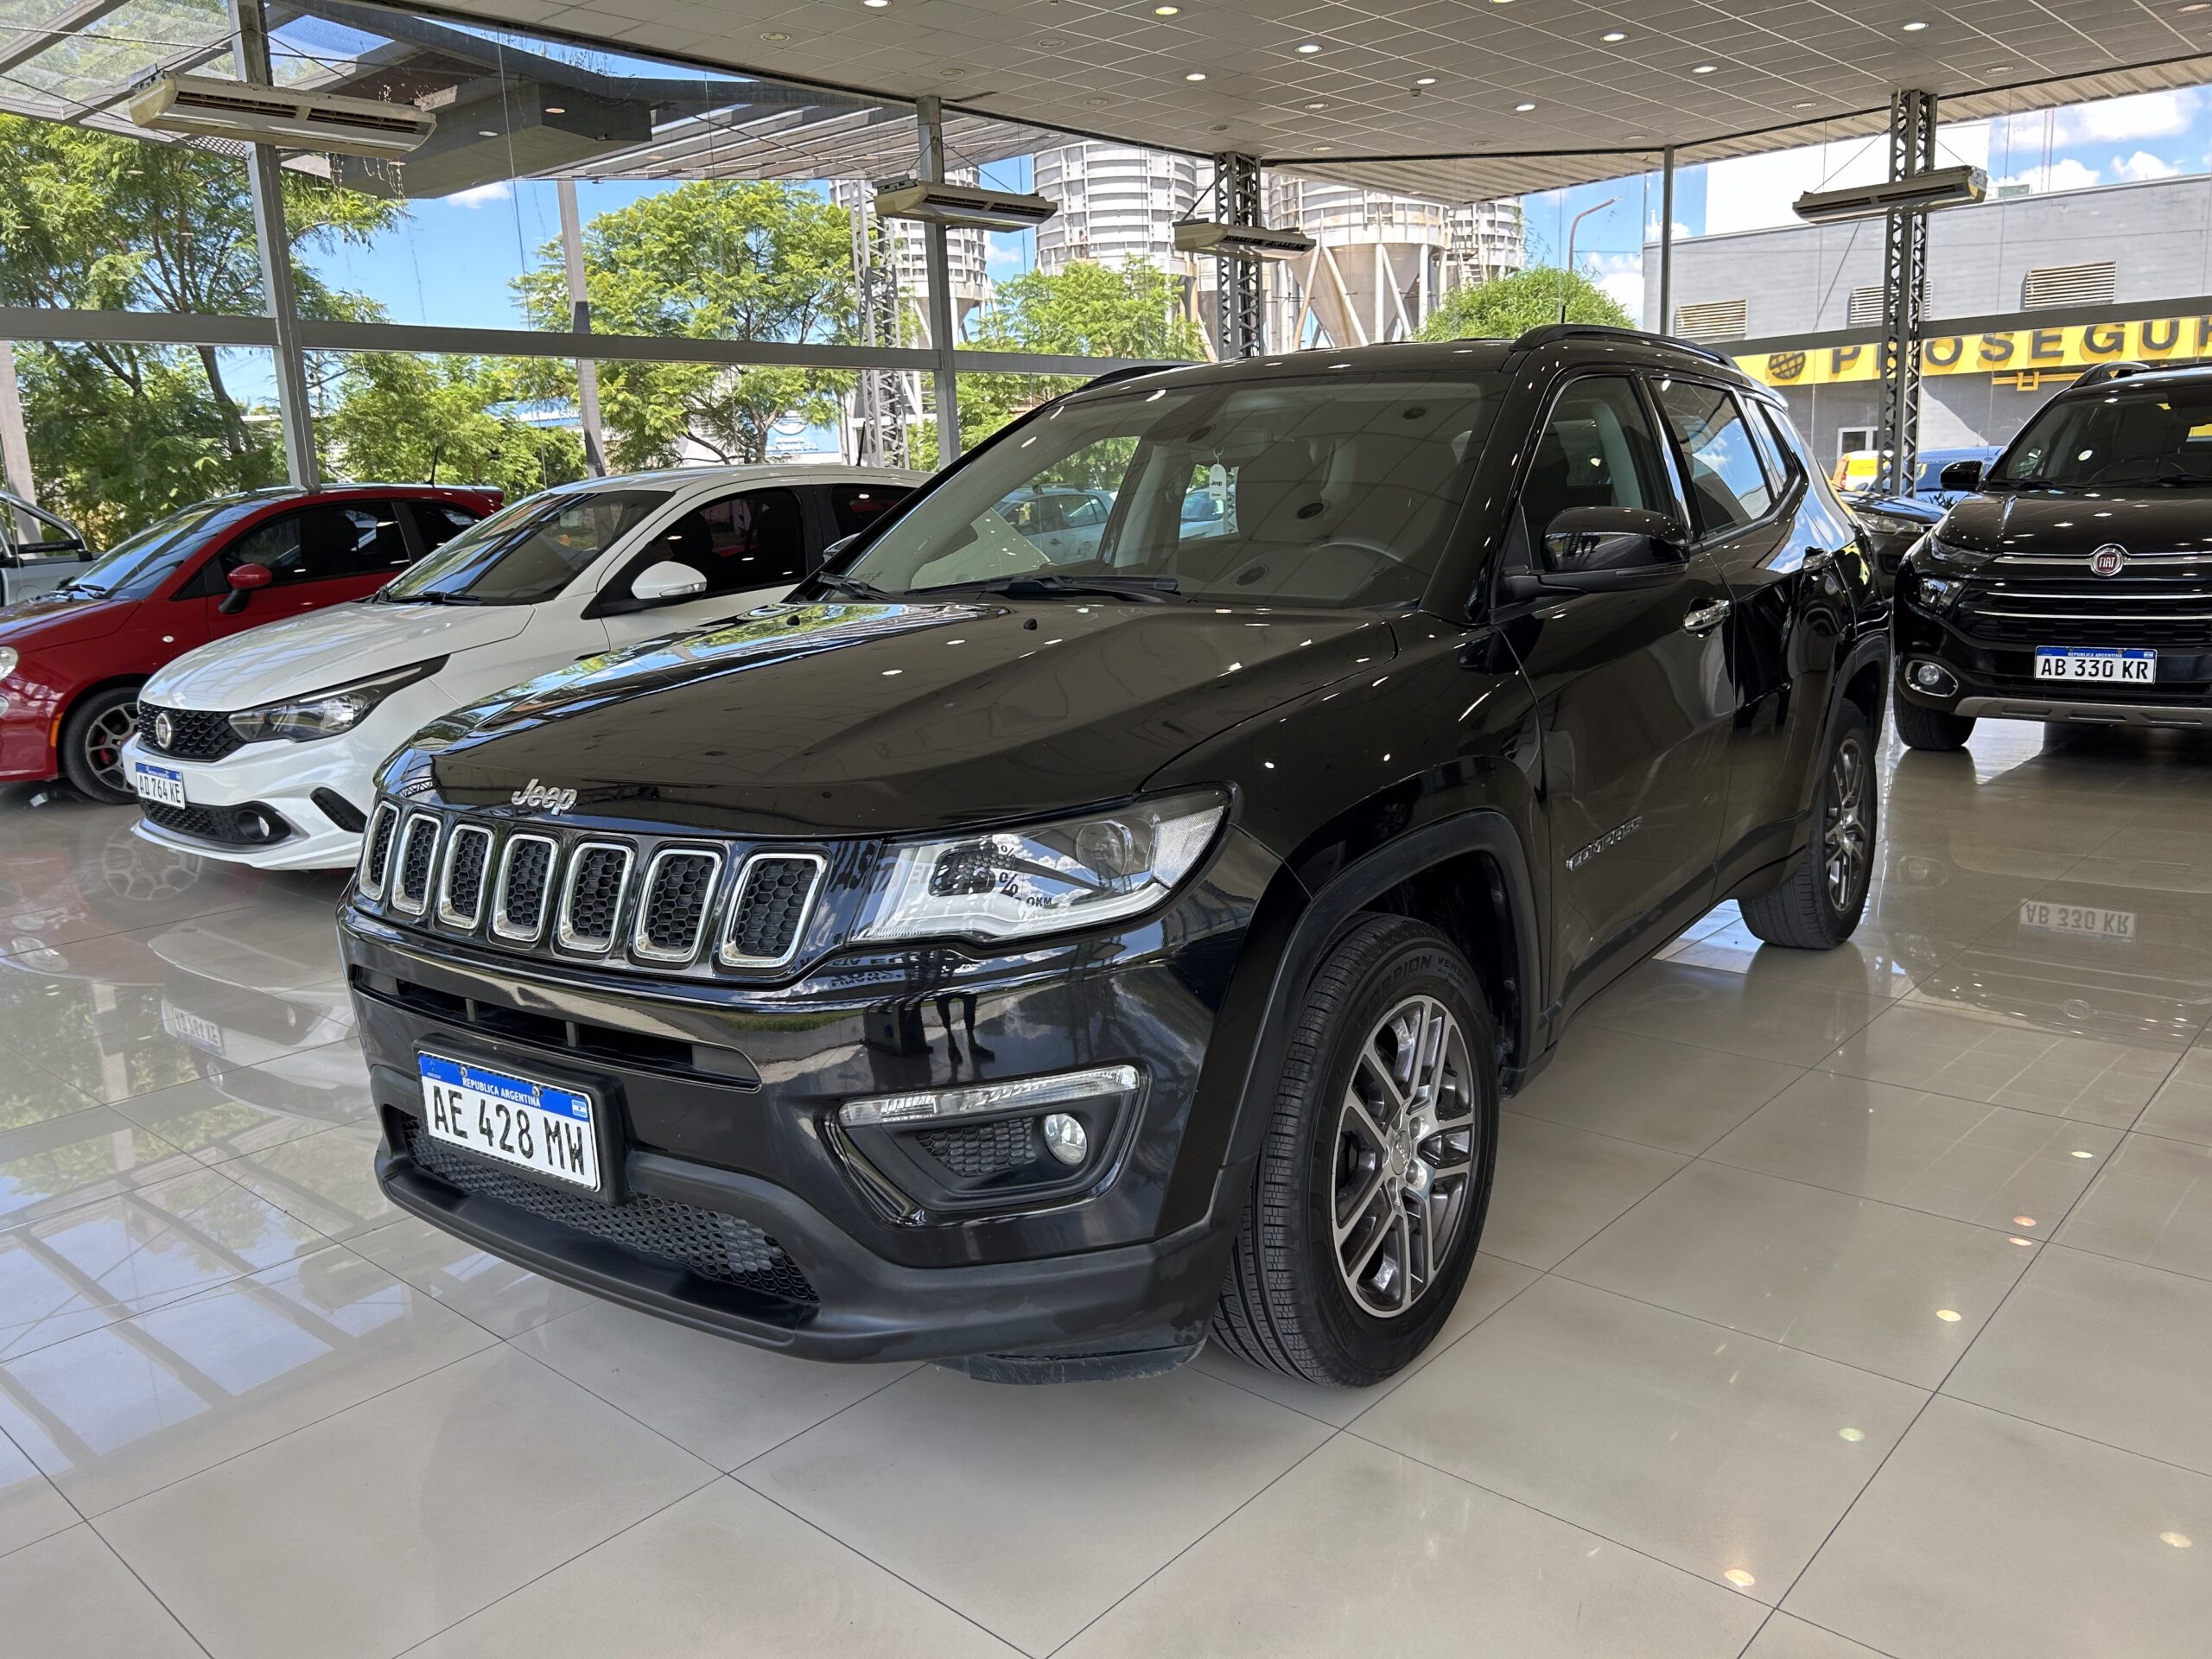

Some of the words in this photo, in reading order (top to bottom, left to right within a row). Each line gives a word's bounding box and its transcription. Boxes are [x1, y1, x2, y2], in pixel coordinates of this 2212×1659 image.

[1831, 316, 2212, 374] POSEGU
[2099, 556, 2116, 568] FIAT
[2041, 658, 2066, 676] AB
[2075, 659, 2114, 677] 330
[2121, 660, 2149, 679] KR
[139, 775, 149, 795] AD
[151, 778, 168, 800] 764
[169, 781, 181, 804] KE
[511, 779, 578, 816] Jeep
[461, 1077, 499, 1097] REPUBLICA
[500, 1087, 541, 1108] ARGENTINA
[433, 1085, 468, 1140] AE
[479, 1098, 534, 1160] 428
[543, 1116, 585, 1176] MW
